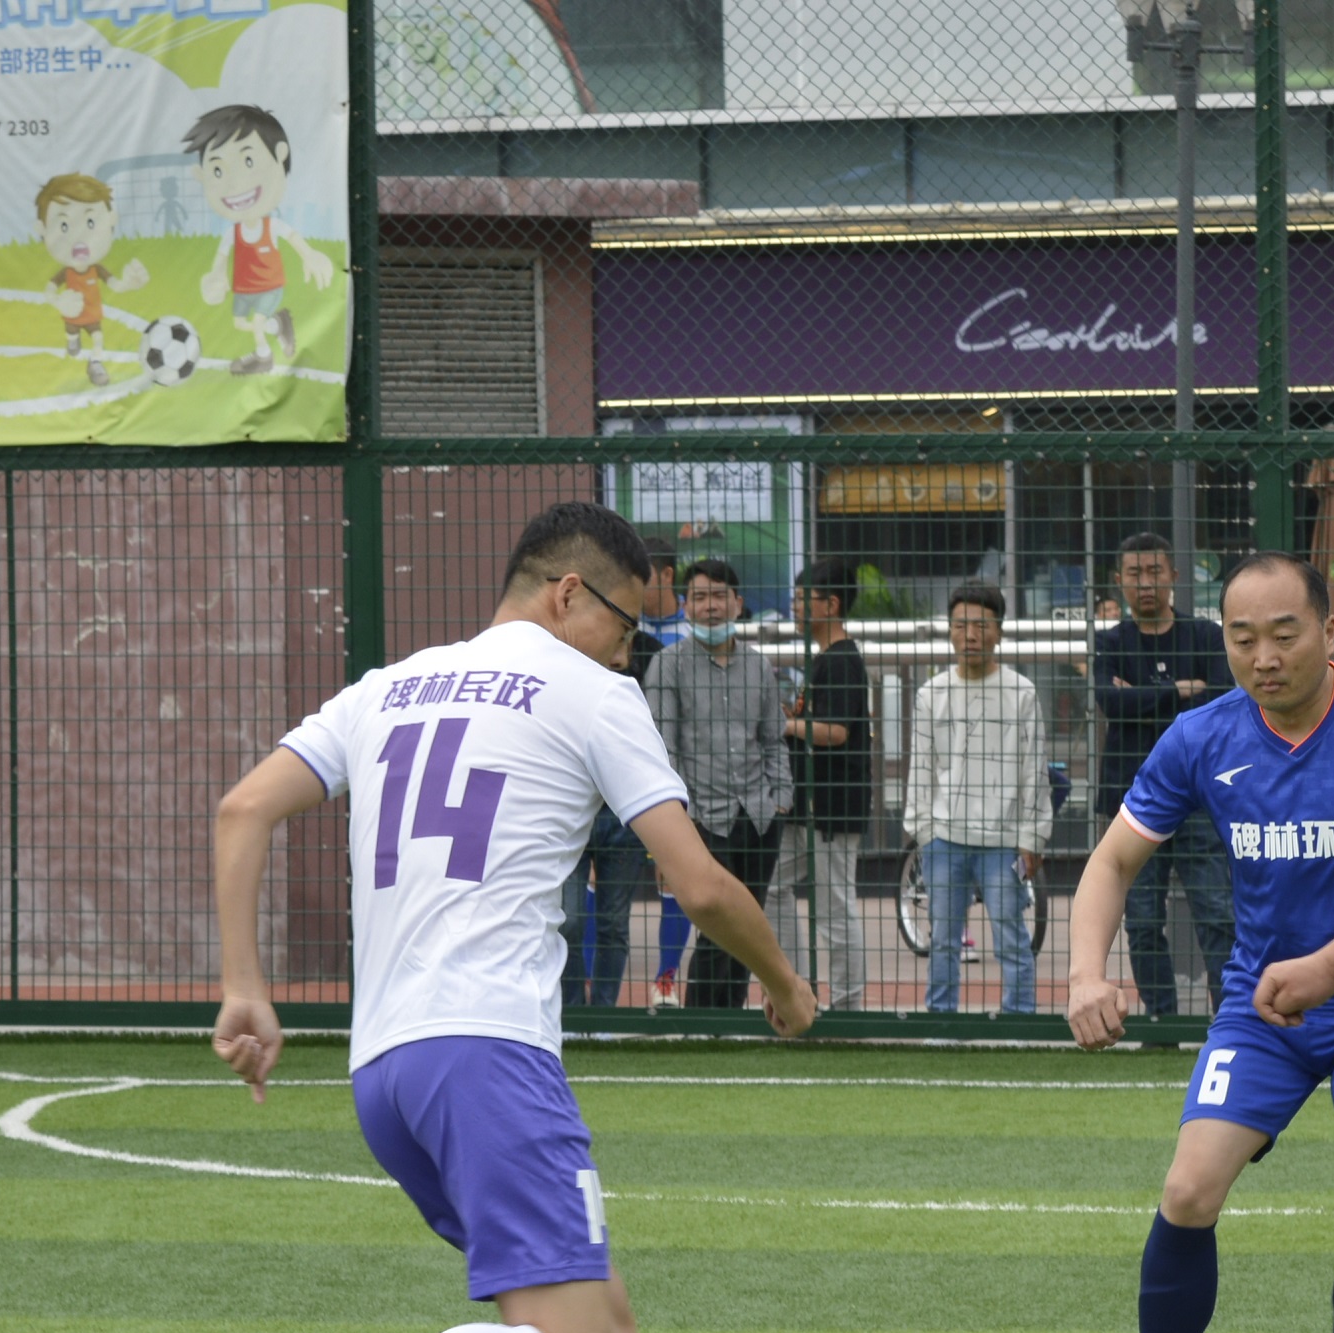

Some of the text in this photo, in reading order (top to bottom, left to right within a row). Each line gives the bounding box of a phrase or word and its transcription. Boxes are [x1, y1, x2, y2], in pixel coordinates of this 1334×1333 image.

[7, 119, 50, 136] 2303
[380, 670, 547, 715] 碑林民政
[374, 718, 507, 890] 14
[1197, 1048, 1237, 1106] 6
